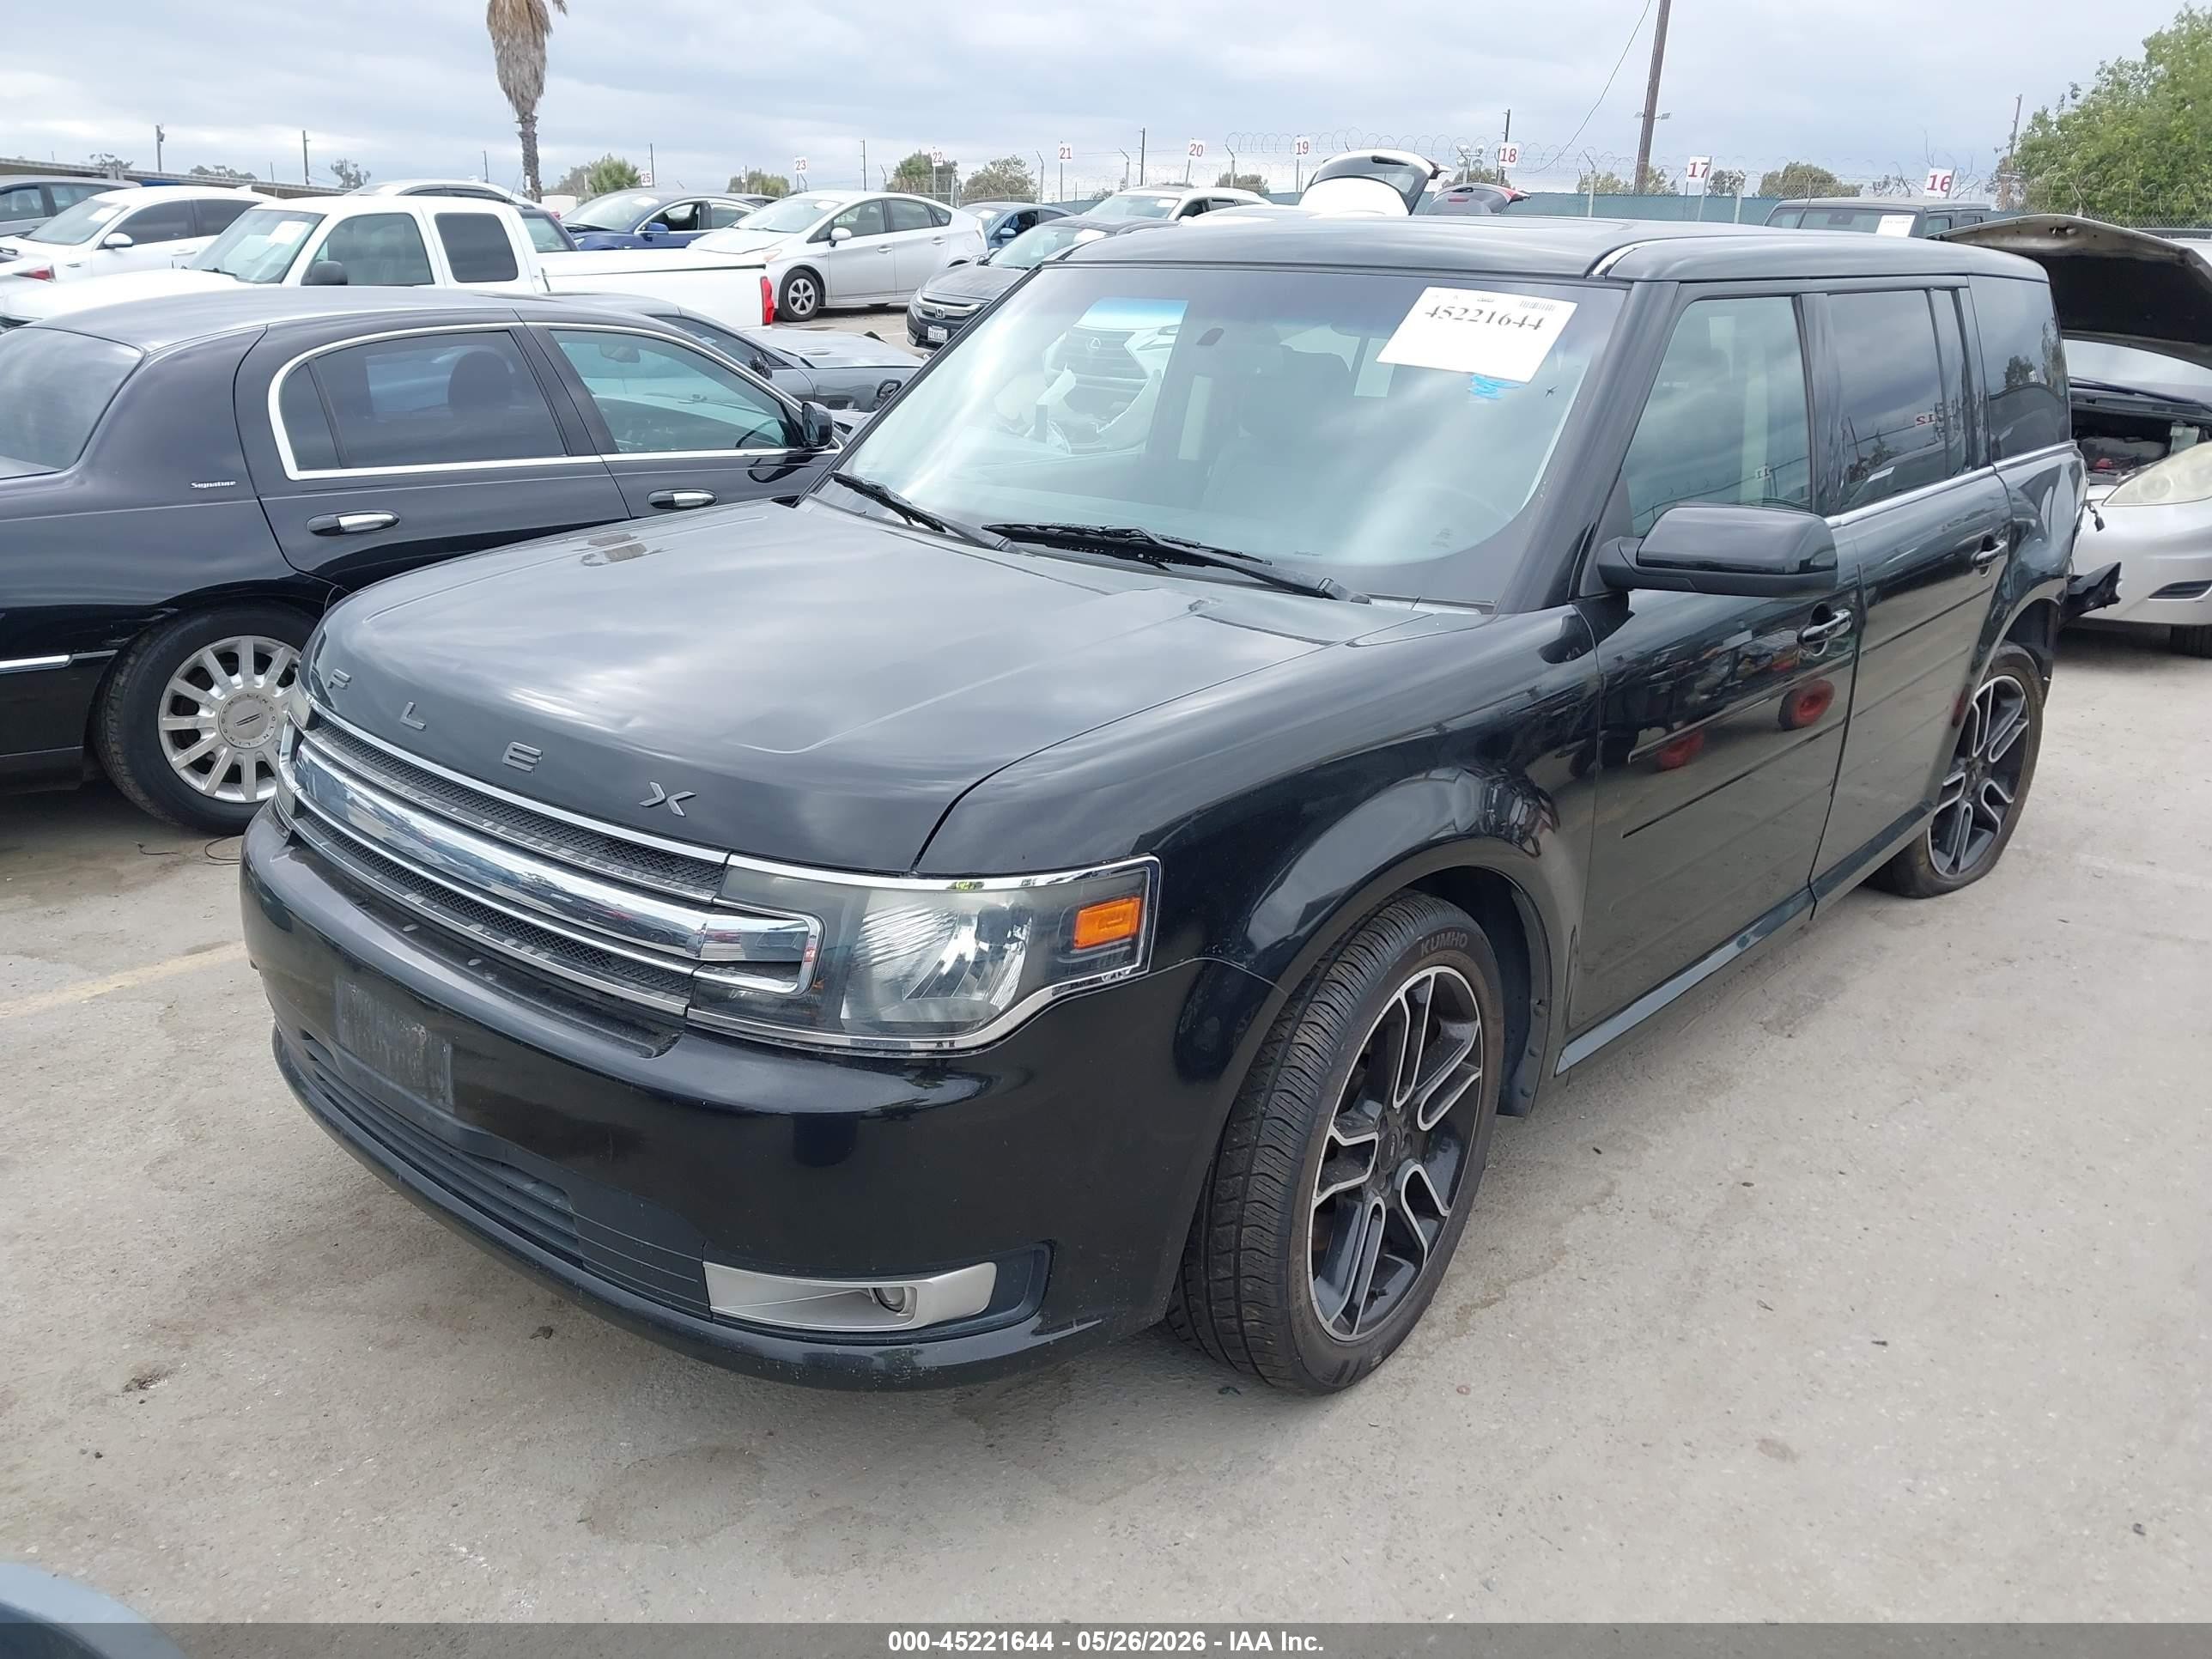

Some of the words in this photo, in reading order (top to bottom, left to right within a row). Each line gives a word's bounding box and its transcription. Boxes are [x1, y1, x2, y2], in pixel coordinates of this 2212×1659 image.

[1059, 147, 1073, 160] 21
[1188, 143, 1204, 157] 20
[1296, 141, 1310, 155] 19
[1499, 147, 1517, 163] 18
[933, 151, 943, 163] 22
[795, 159, 806, 171] 23
[1687, 161, 1711, 179] 17
[641, 172, 652, 184] 25
[1926, 173, 1953, 193] 16
[1424, 305, 1545, 331] 45221644
[328, 668, 696, 817] FLEX
[1421, 931, 1468, 957] KUMHO
